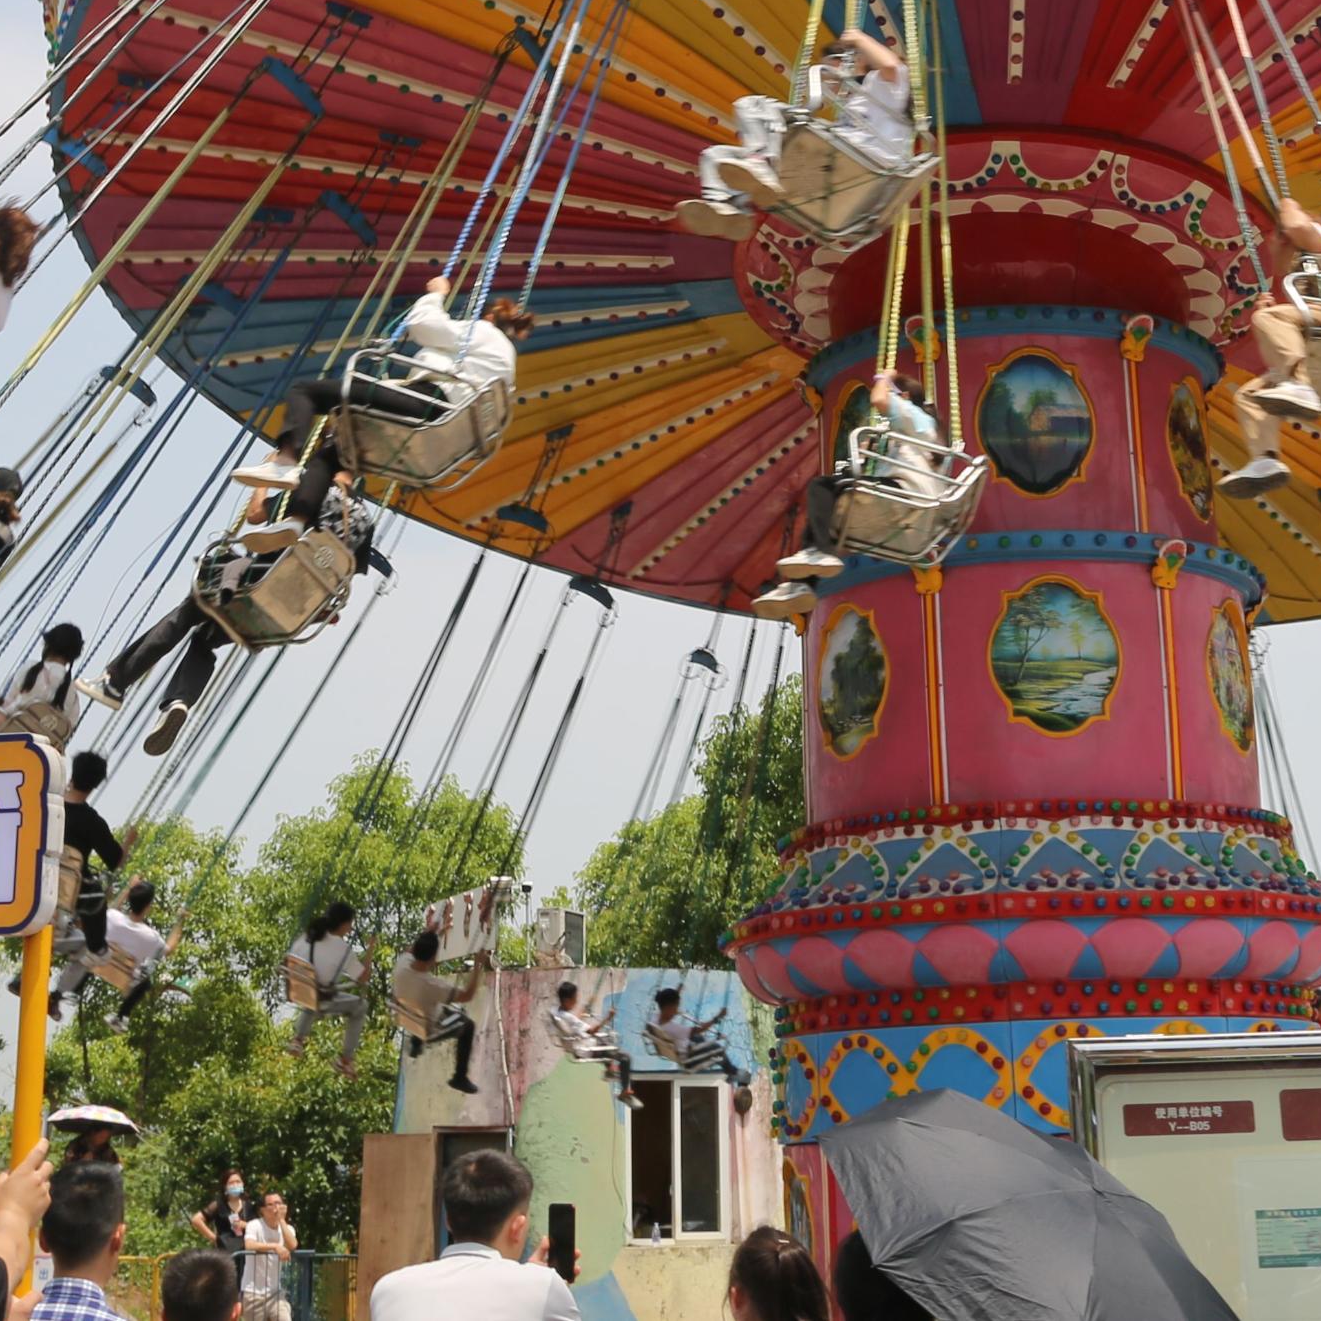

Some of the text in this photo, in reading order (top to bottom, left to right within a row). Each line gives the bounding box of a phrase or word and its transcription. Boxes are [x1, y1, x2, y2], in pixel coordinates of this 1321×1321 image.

[1155, 1105, 1223, 1120] 使用单位编号
